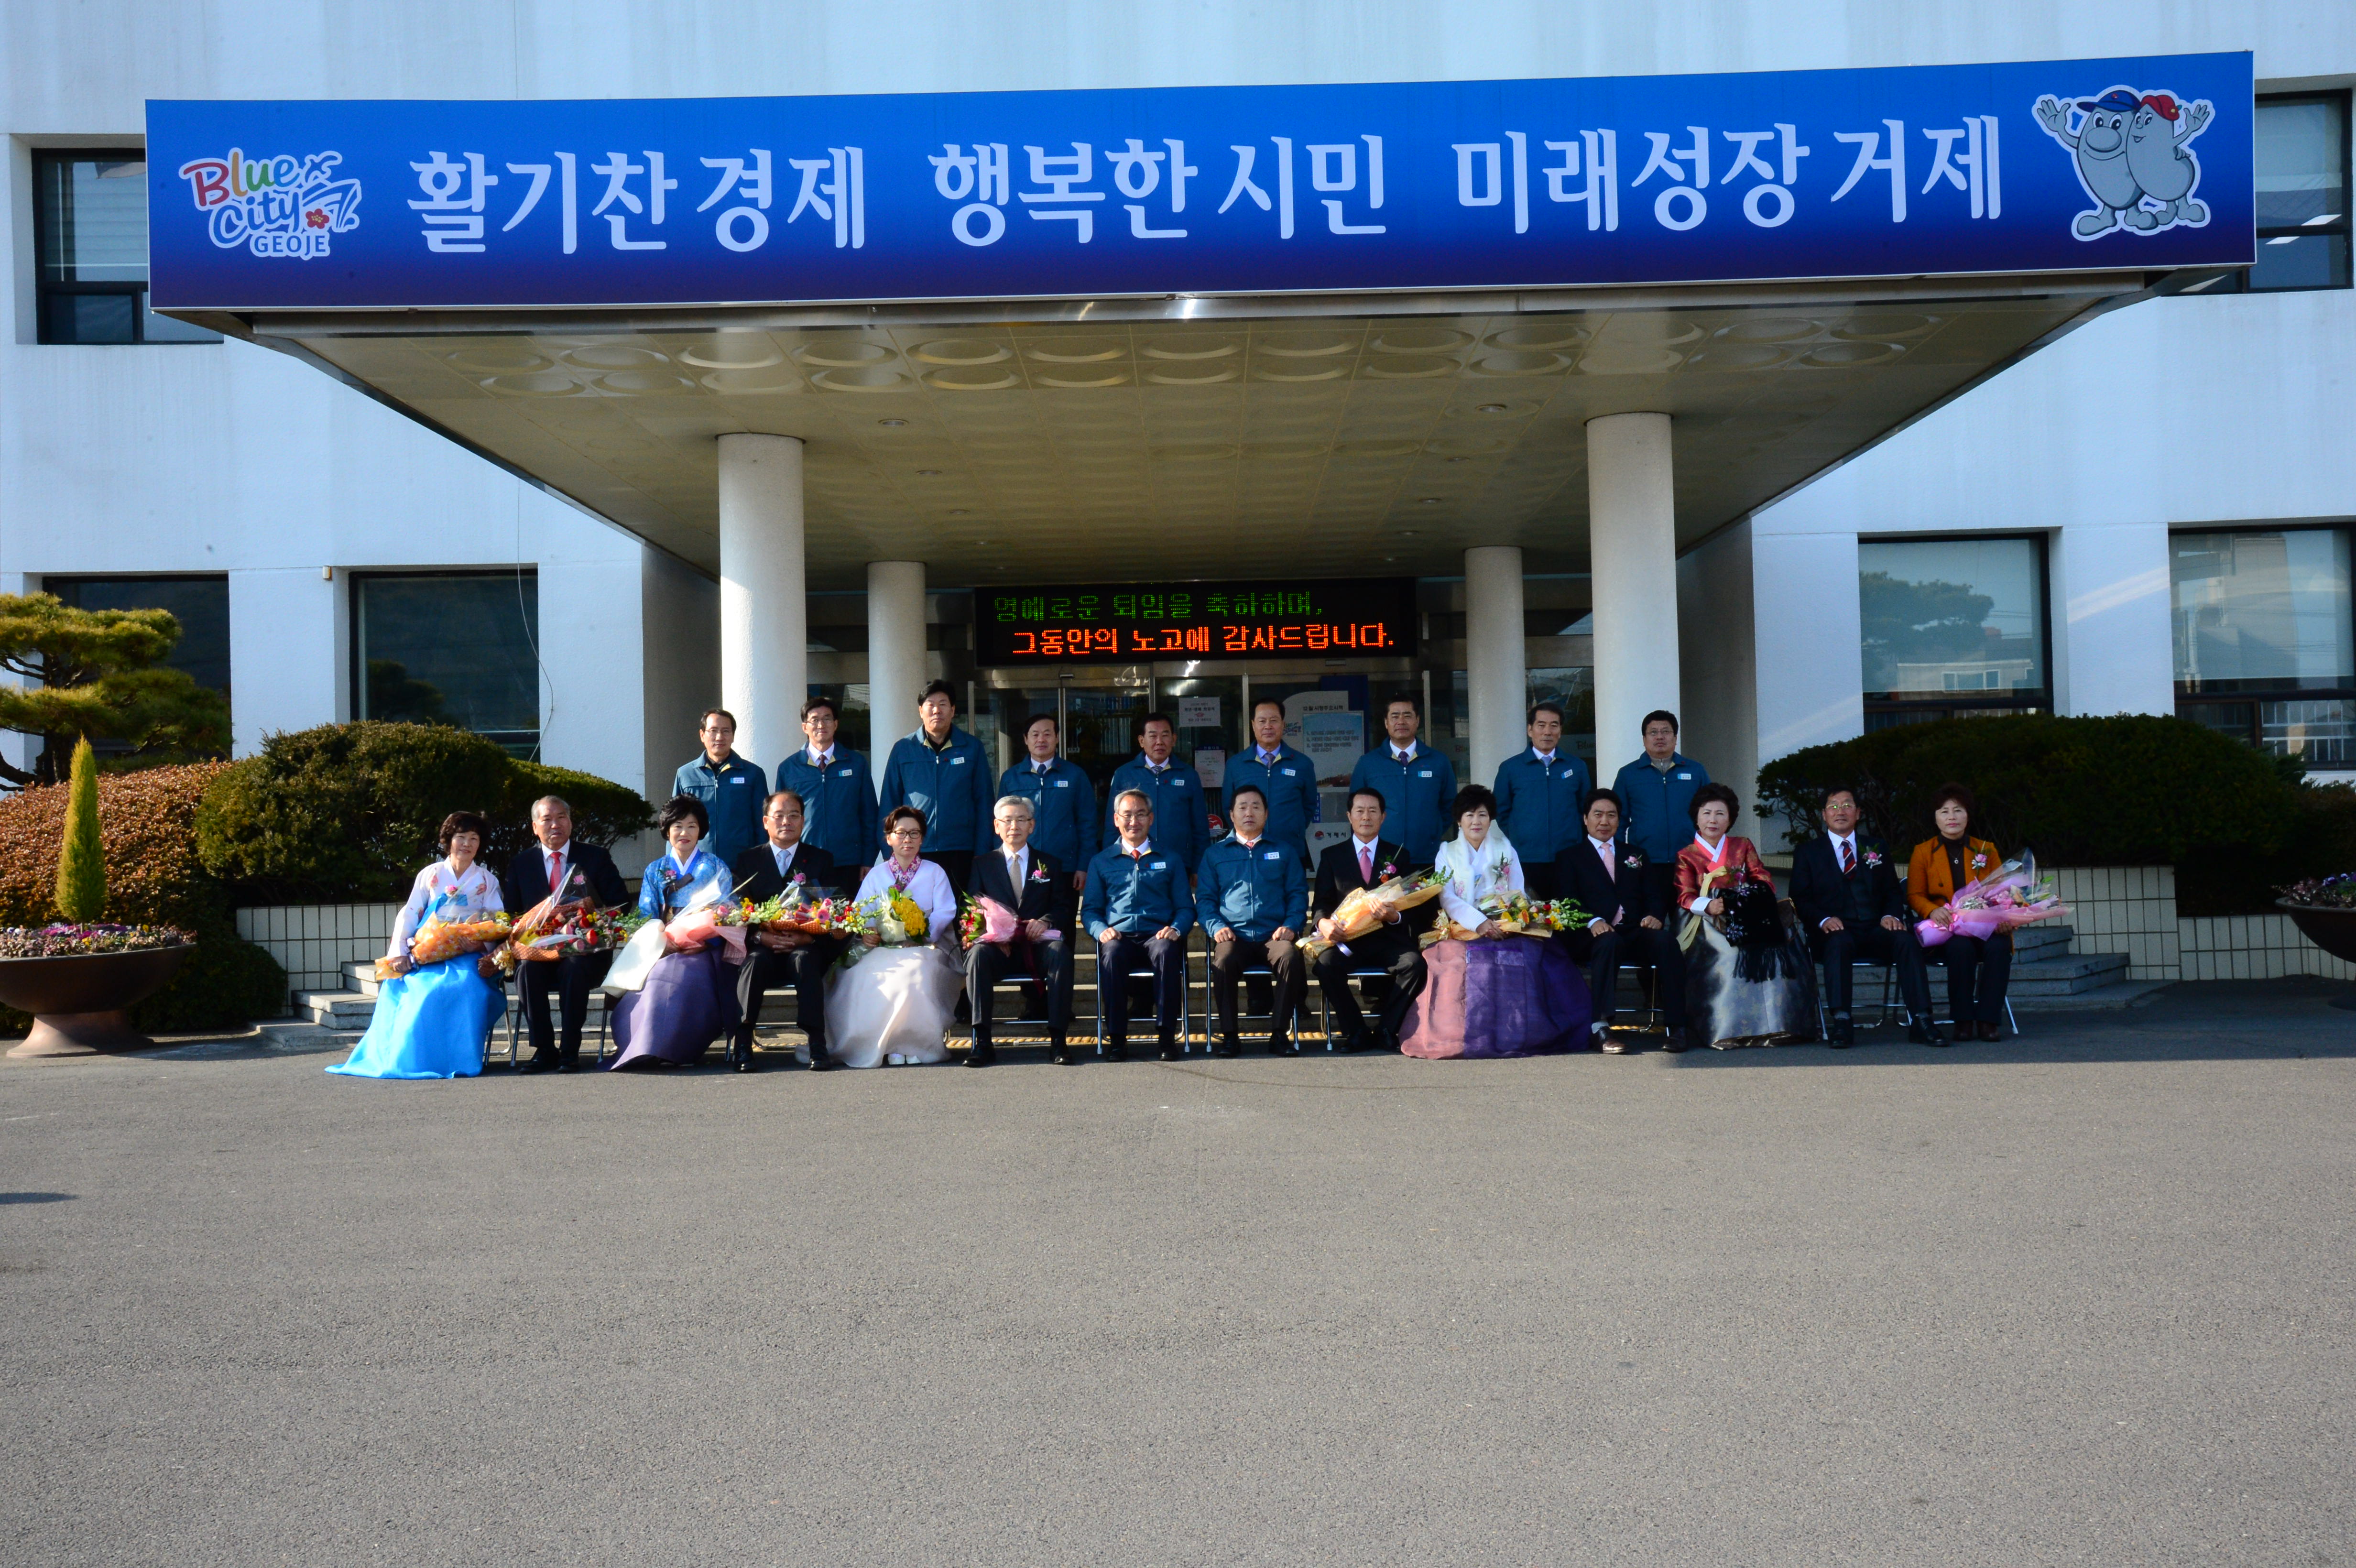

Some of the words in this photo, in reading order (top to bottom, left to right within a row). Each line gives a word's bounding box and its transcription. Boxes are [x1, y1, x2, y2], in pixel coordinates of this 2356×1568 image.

[183, 151, 300, 207] Blue
[213, 191, 300, 245] City
[254, 234, 327, 257] GEOJE
[1114, 594, 1192, 619] 퇴임을
[1206, 591, 1322, 617] 축하하며,
[1013, 628, 1118, 655] 그동안의
[1132, 627, 1210, 652] 노고에
[1223, 623, 1394, 651] 감사드립니다.
